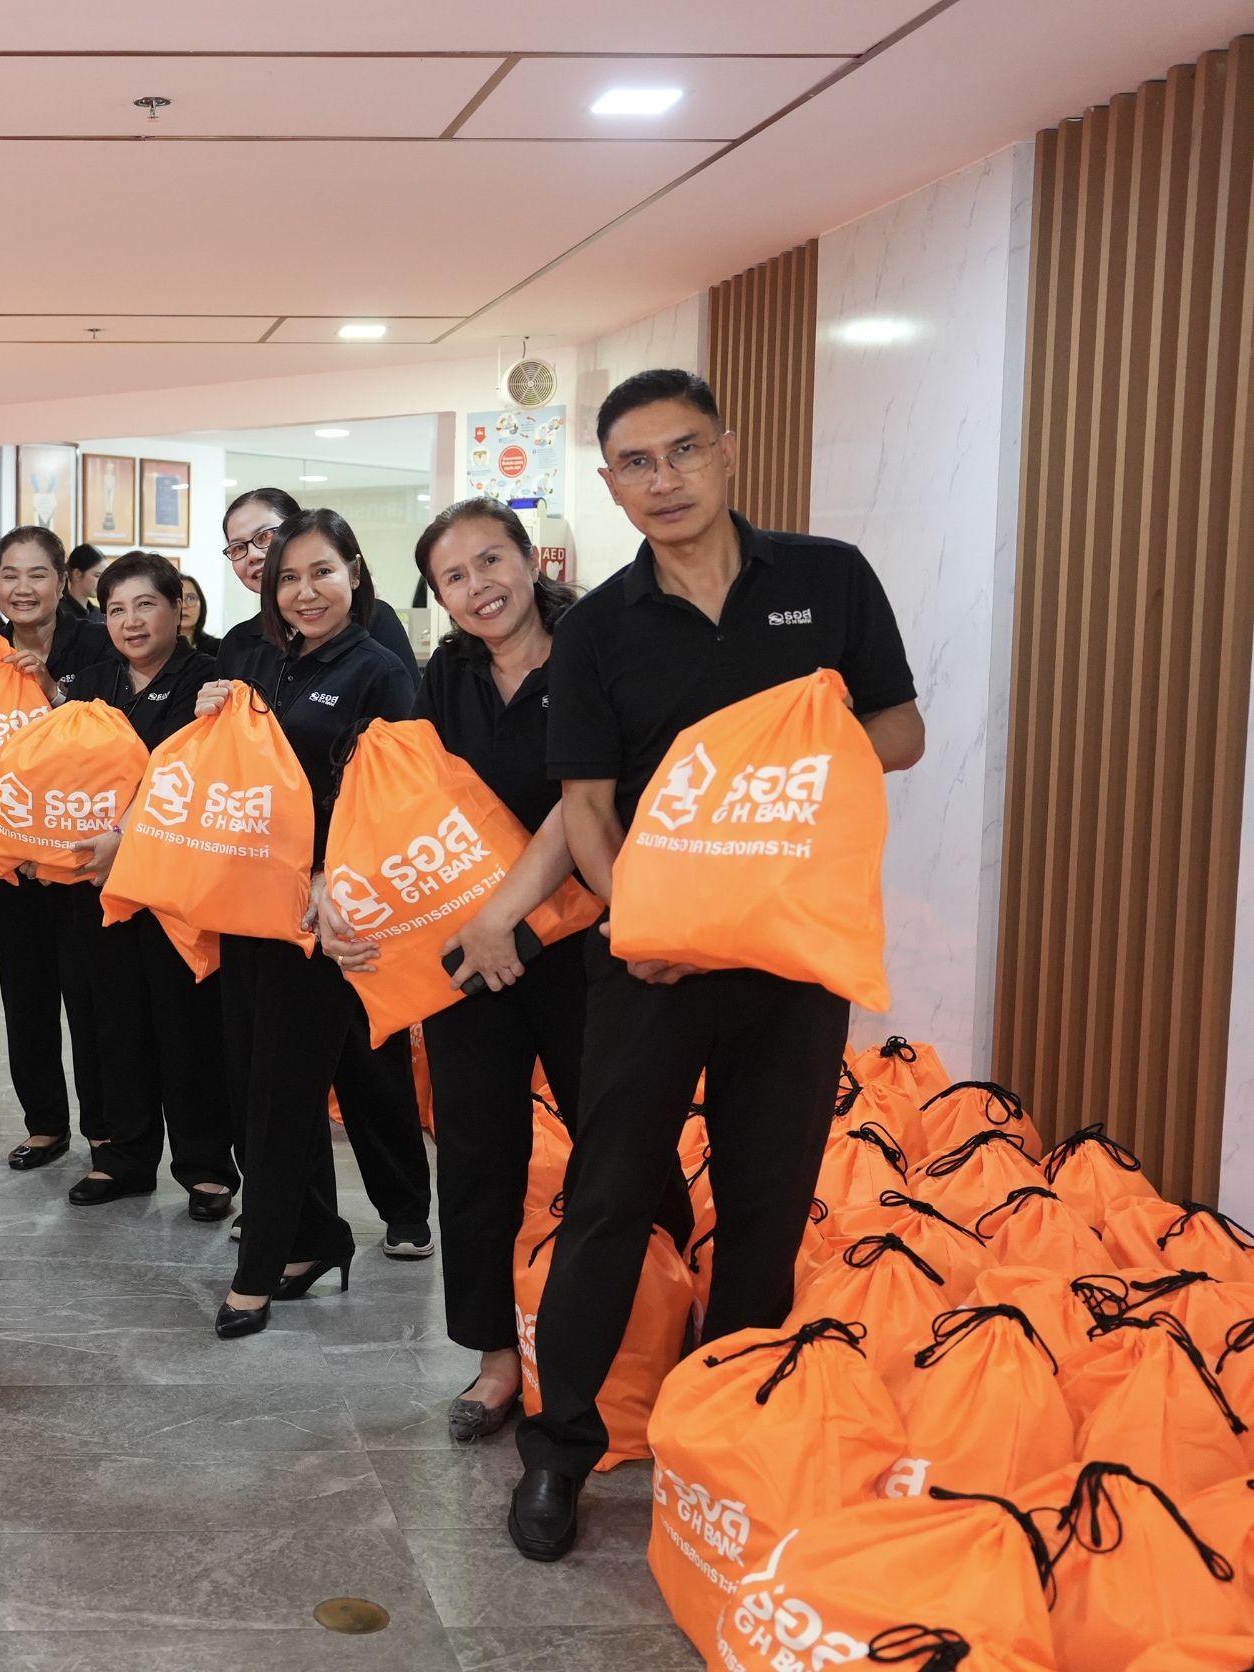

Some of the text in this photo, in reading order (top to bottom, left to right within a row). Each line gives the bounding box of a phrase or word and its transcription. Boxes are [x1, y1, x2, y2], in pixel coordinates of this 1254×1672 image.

[542, 548, 566, 561] AED
[44, 789, 118, 818] ธอส
[205, 782, 275, 818] ธอส
[754, 801, 820, 825] BANK
[76, 817, 116, 831] BANK
[135, 822, 270, 858] ธนาคารอาคารสงเคราะห์
[229, 816, 271, 835] BANK
[381, 805, 479, 891] ธอส
[437, 840, 491, 884] BANK
[704, 1521, 745, 1567] BANK
